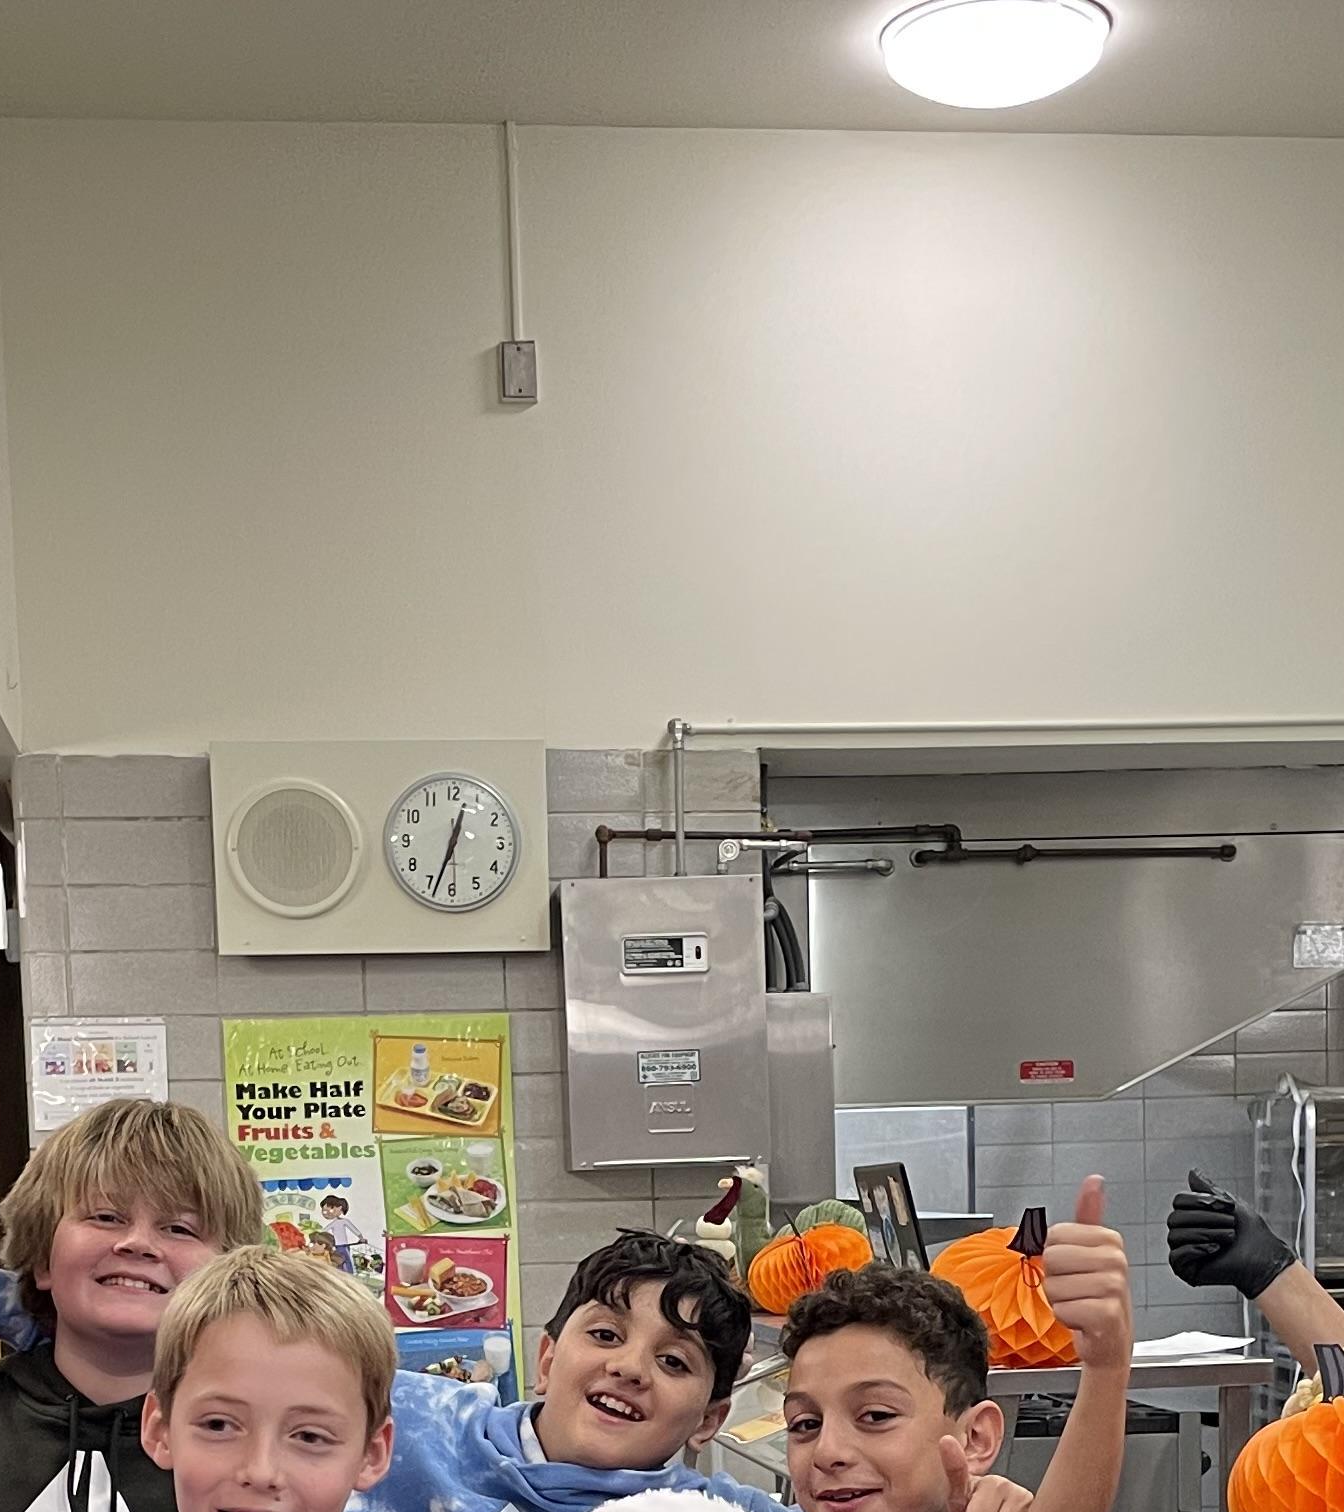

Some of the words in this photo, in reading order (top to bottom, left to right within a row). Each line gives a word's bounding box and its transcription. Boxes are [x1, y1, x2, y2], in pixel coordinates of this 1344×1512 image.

[425, 791, 436, 807] 11
[447, 786, 460, 801] 12
[406, 809, 420, 824] 10
[490, 812, 499, 827] 2
[401, 833, 411, 848] 9
[496, 836, 505, 850] 3
[408, 857, 417, 872] 8
[489, 860, 498, 875] 4
[425, 875, 434, 889] 7
[447, 882, 456, 897] 6
[471, 876, 481, 890] 5
[296, 1058, 333, 1076] Eating
[235, 1082, 302, 1100] Make
[309, 1080, 364, 1098] Half
[236, 1103, 297, 1120] Your
[304, 1101, 366, 1119] Plate
[237, 1122, 314, 1141] Fruits
[319, 1122, 337, 1139] &
[238, 1142, 376, 1164] Vegetables
